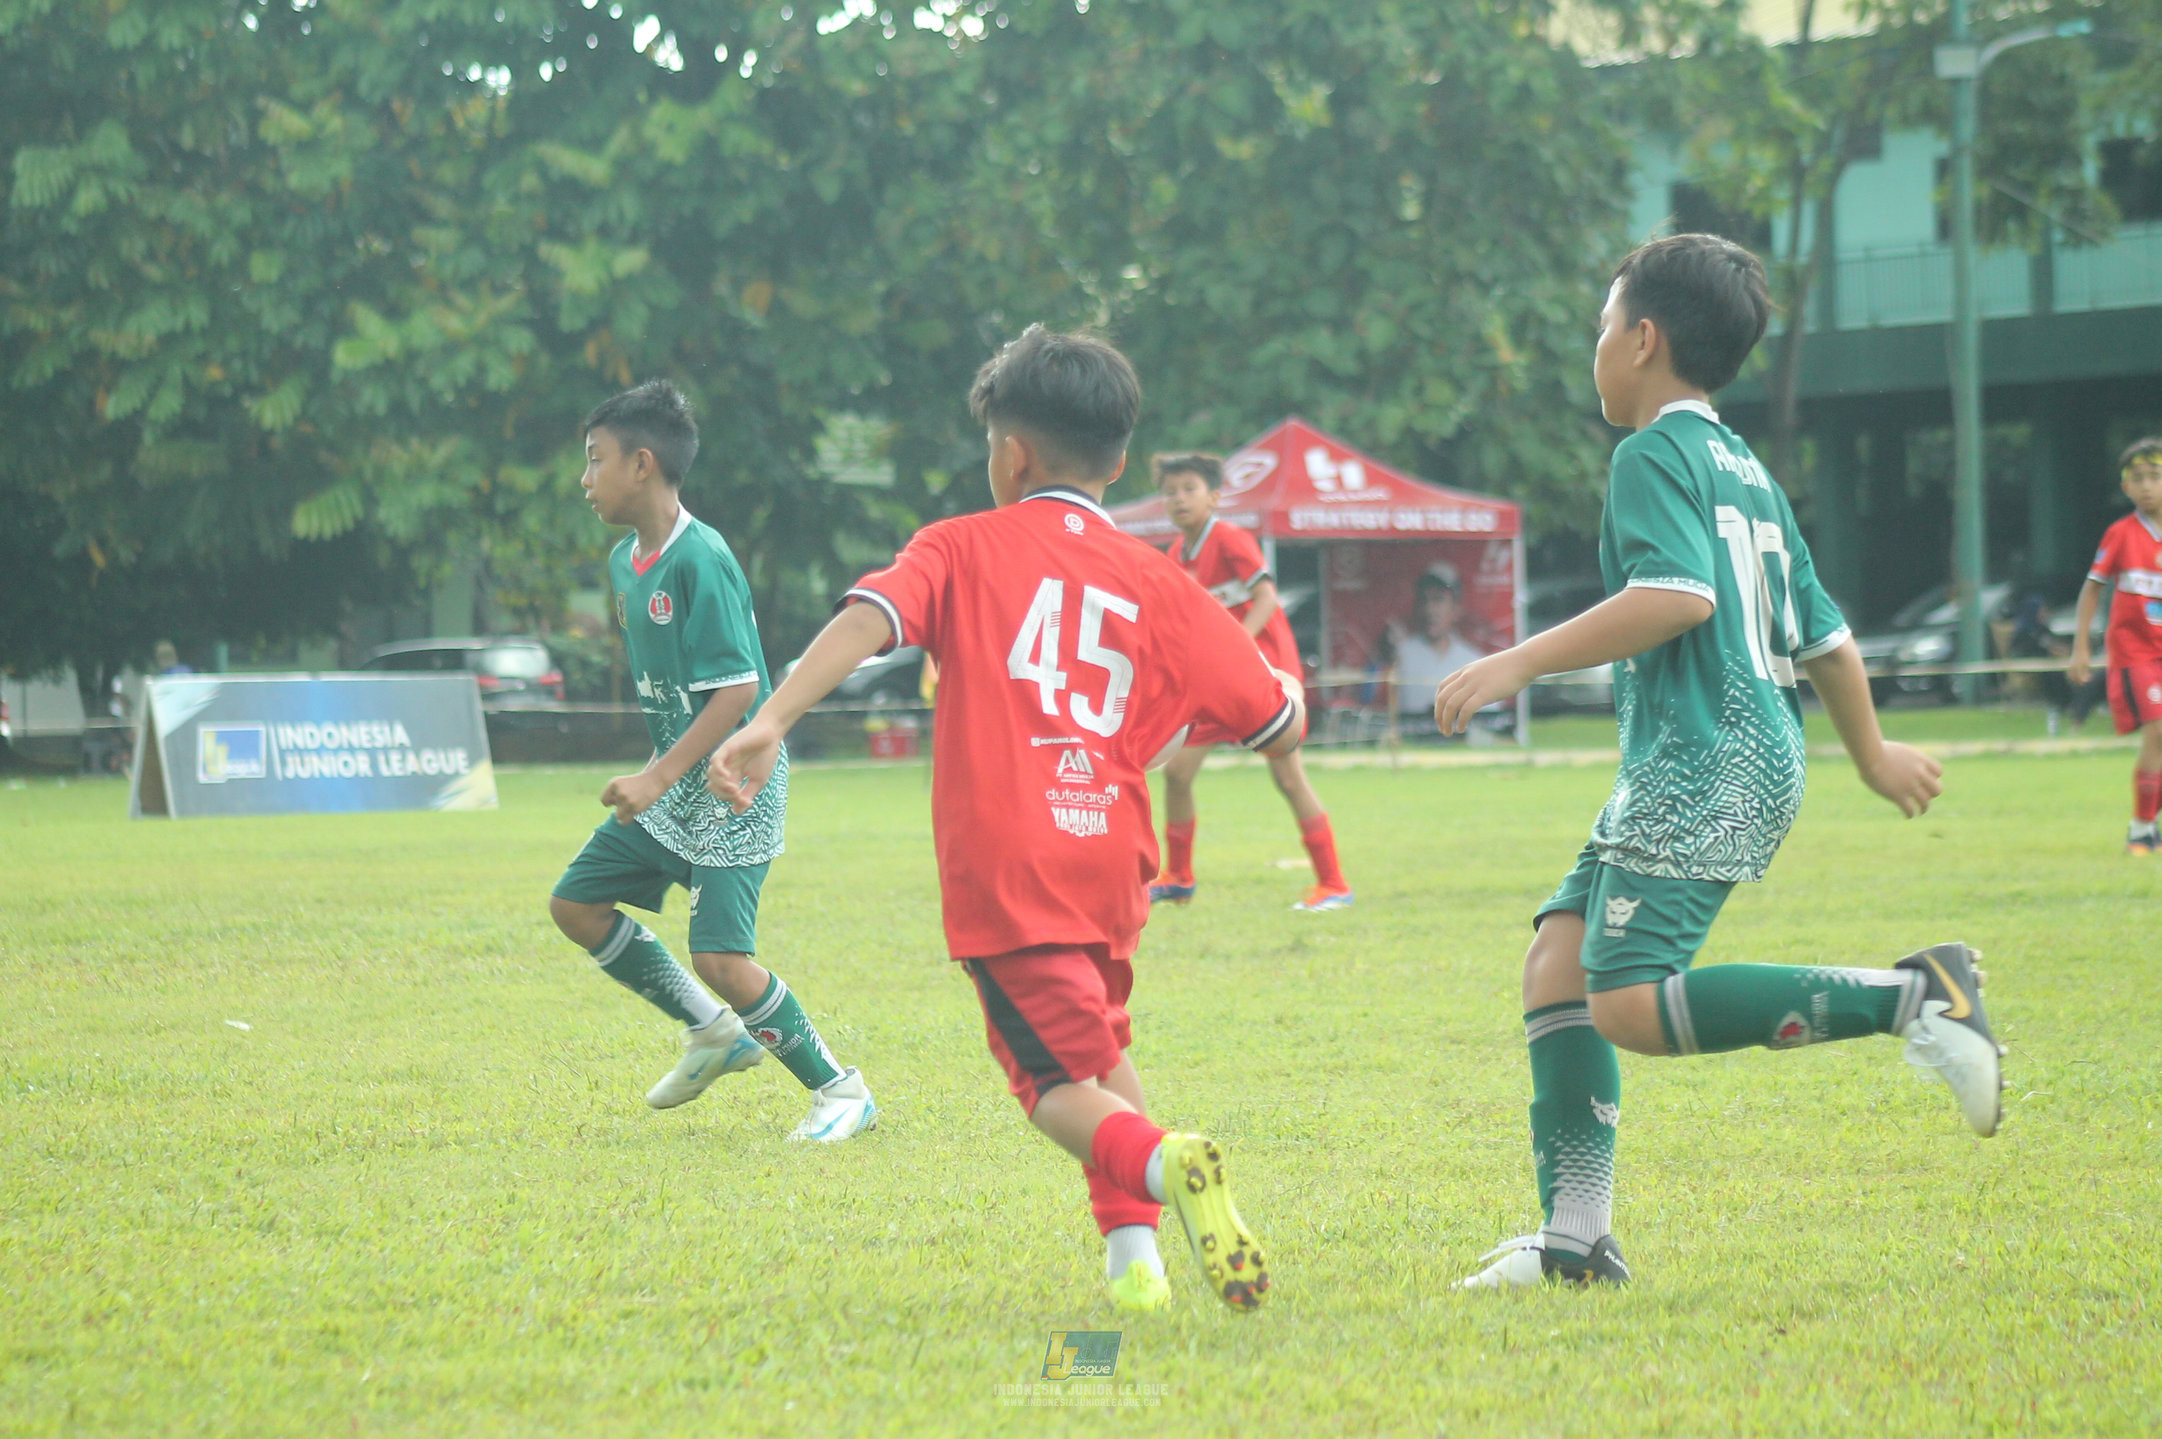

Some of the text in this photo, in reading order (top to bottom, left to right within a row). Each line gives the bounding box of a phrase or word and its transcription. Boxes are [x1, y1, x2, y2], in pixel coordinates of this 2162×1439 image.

[1715, 505, 1799, 688] 10
[1007, 577, 1139, 738] 45
[278, 721, 410, 750] INDONESIA
[284, 747, 469, 779] JUNIOR LEAGUE
[1046, 789, 1113, 806] dutalaras
[1051, 807, 1108, 835] YAMAHA
